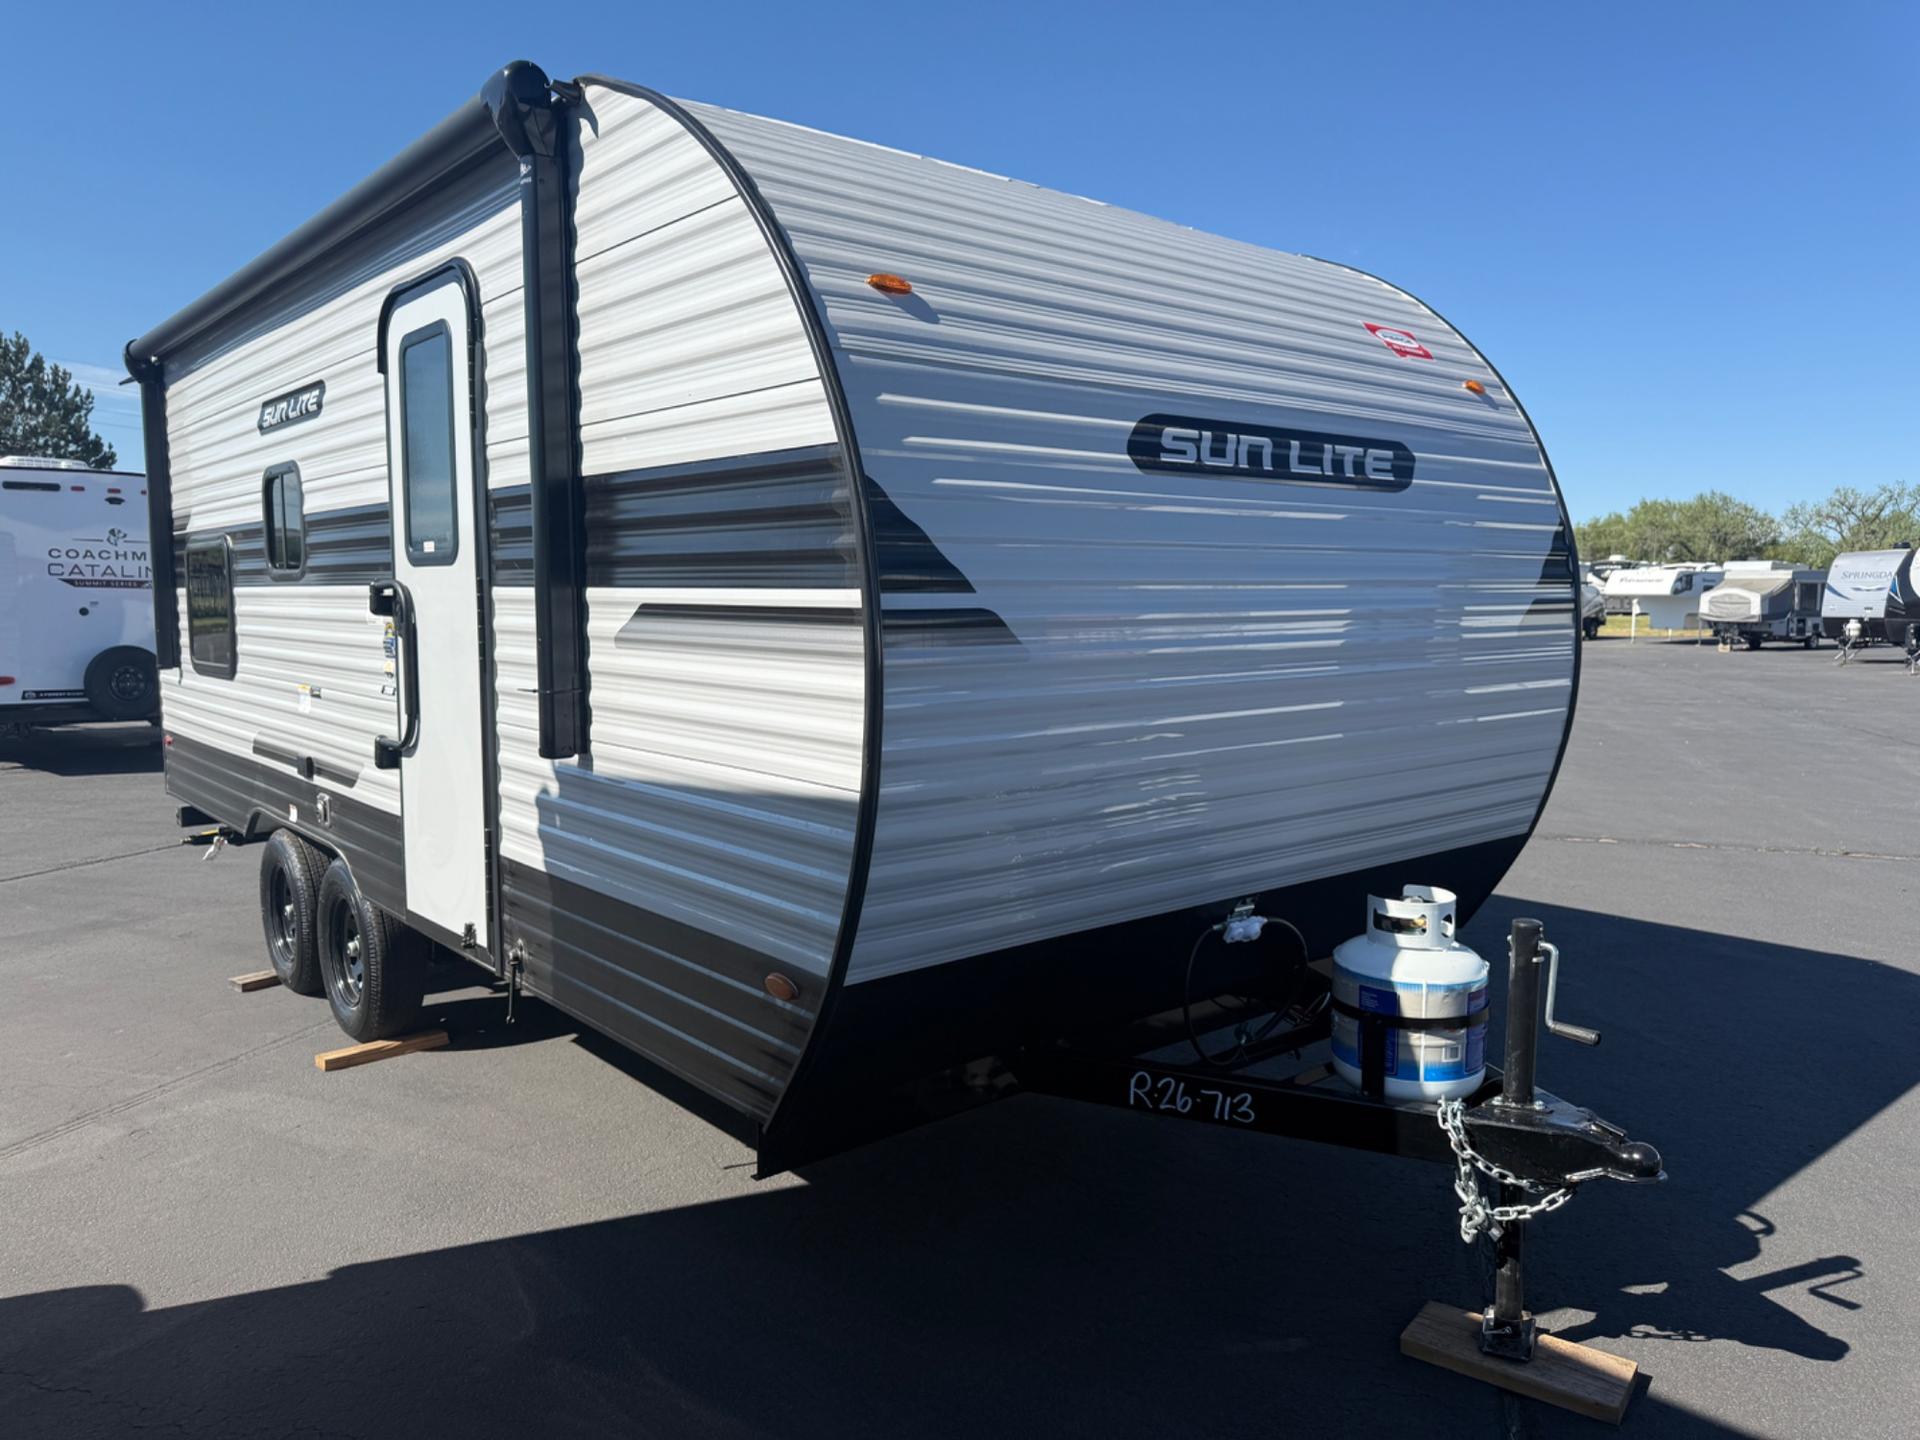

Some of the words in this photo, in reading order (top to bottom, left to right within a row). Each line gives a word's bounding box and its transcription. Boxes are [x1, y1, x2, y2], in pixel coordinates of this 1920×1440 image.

[288, 389, 320, 419] LITE
[1160, 427, 1273, 471] SUN
[1289, 440, 1395, 481] LITE
